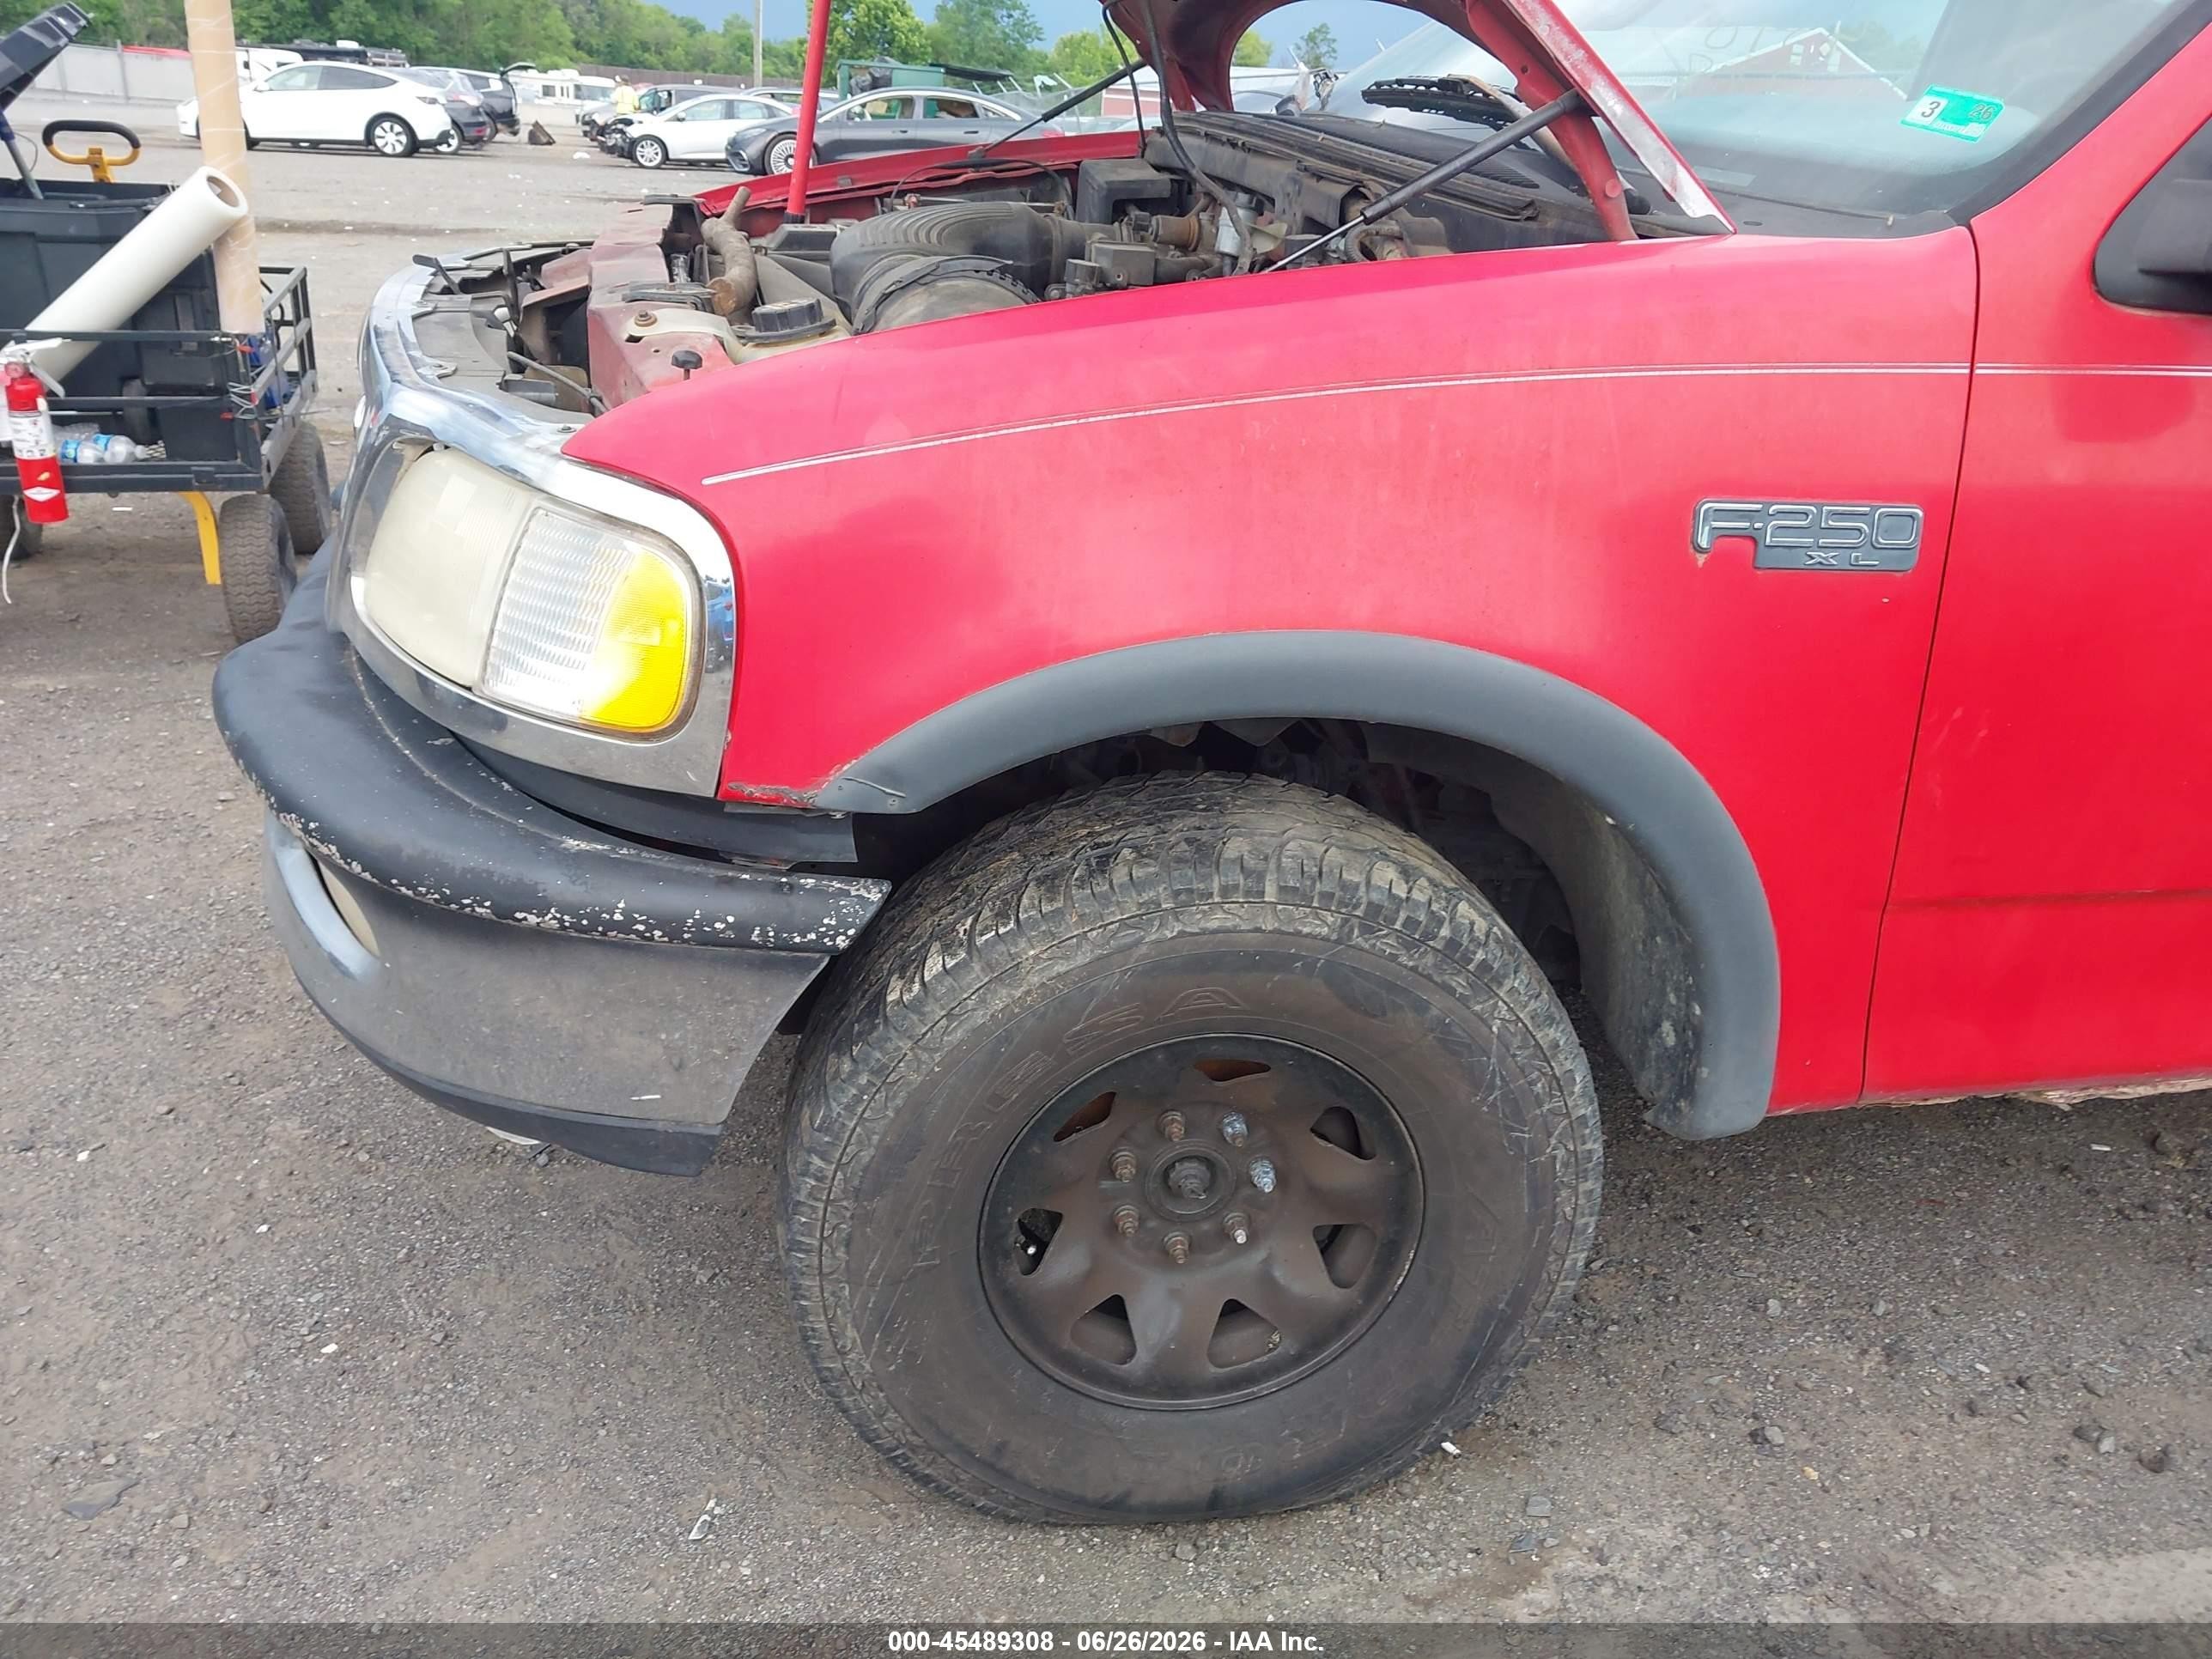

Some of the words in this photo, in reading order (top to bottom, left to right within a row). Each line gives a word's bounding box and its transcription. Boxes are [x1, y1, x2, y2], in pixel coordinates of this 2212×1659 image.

[1921, 100, 1941, 118] 3
[1968, 103, 1996, 120] 26
[1695, 502, 1924, 550] F-250
[1804, 551, 1881, 566] XL
